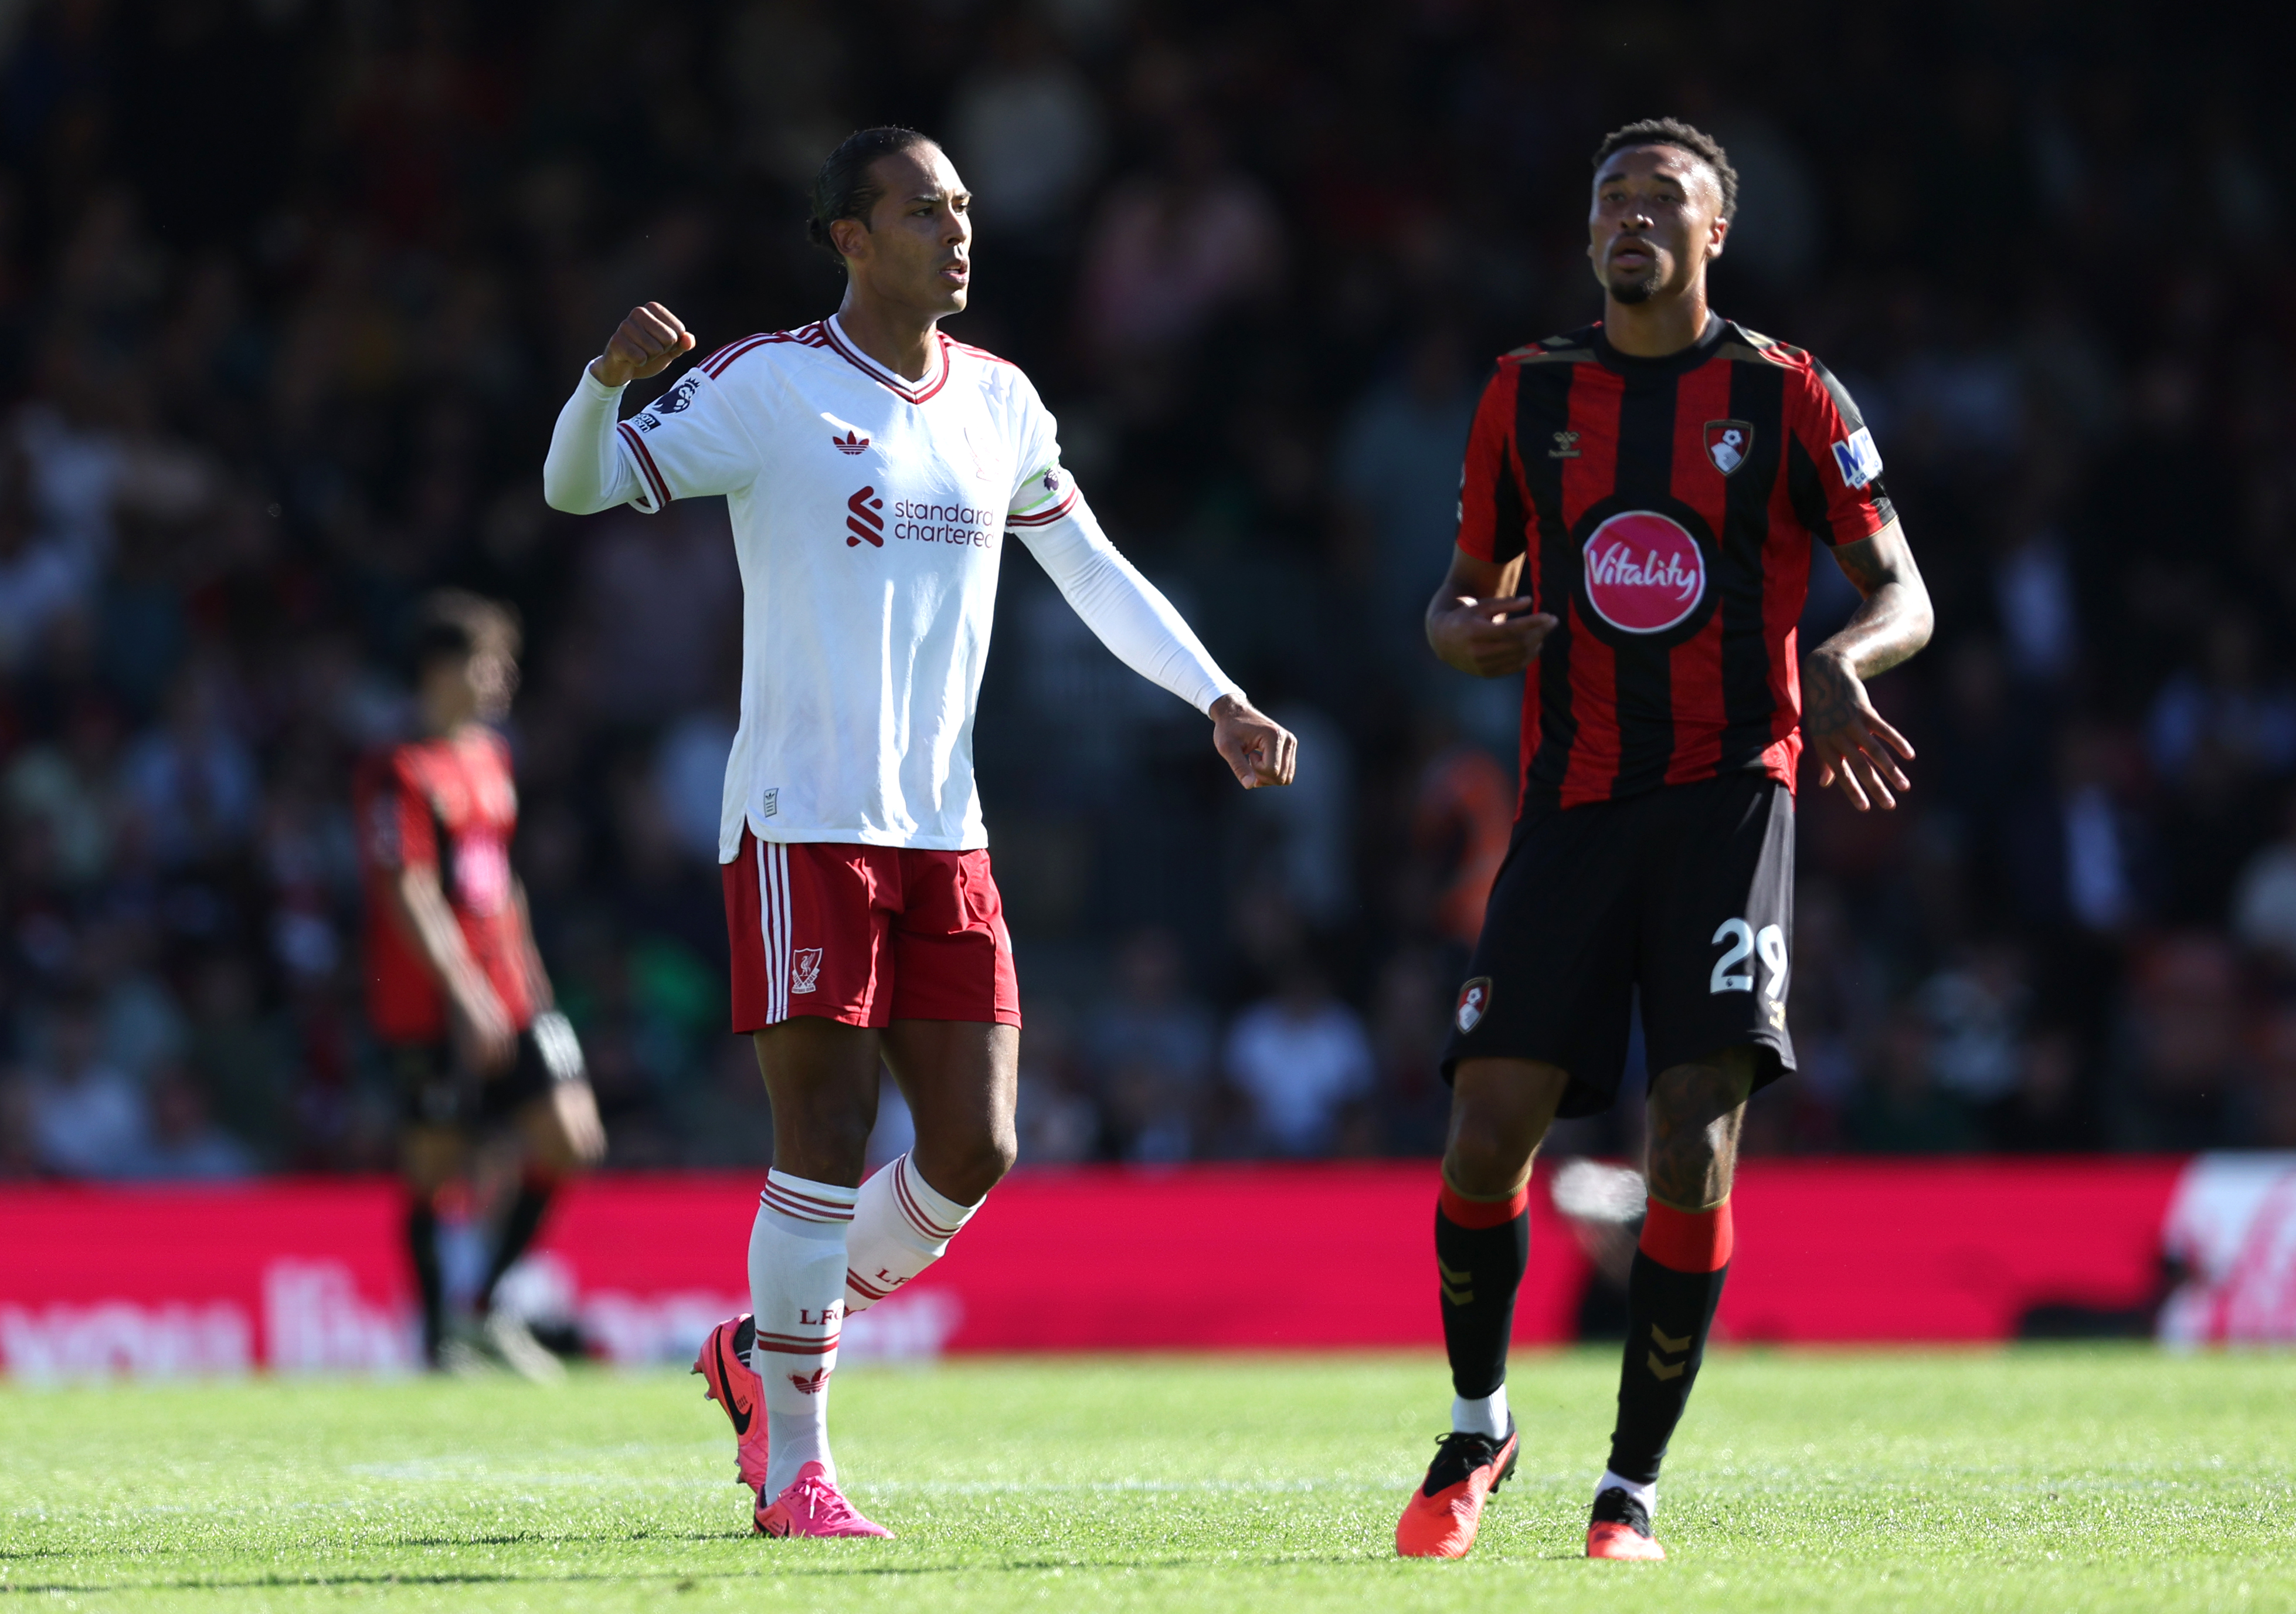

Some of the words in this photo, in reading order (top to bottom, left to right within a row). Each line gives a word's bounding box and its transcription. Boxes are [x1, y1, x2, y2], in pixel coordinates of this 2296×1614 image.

[895, 499, 993, 526] standard
[895, 521, 994, 548] chartered
[1589, 541, 1696, 601] Vitality
[1710, 917, 1788, 999] 29
[800, 1307, 842, 1325] LFC
